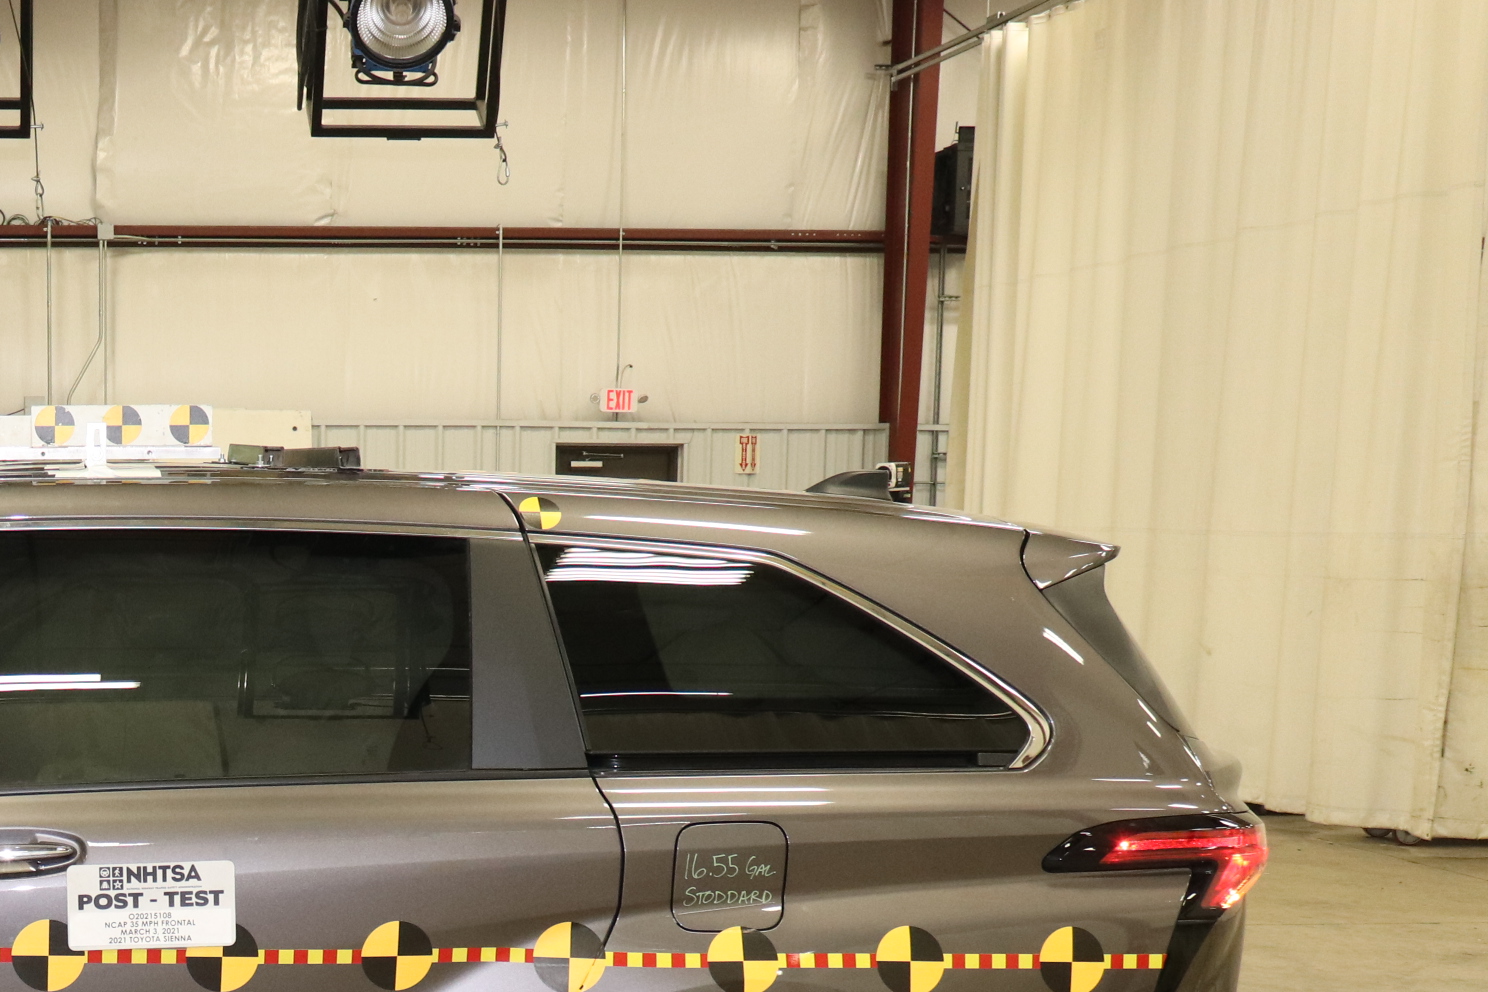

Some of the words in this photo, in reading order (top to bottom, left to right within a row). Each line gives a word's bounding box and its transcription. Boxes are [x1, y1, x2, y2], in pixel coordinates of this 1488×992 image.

[606, 389, 634, 411] EXIT
[126, 864, 202, 884] NHTSA
[684, 853, 739, 880] 16.55
[78, 893, 144, 910] POST
[163, 890, 224, 907] TEST
[683, 886, 773, 907] STODDARD
[105, 921, 127, 929] NCAP
[161, 919, 196, 927] FRONTAL
[120, 928, 150, 936] MARCH
